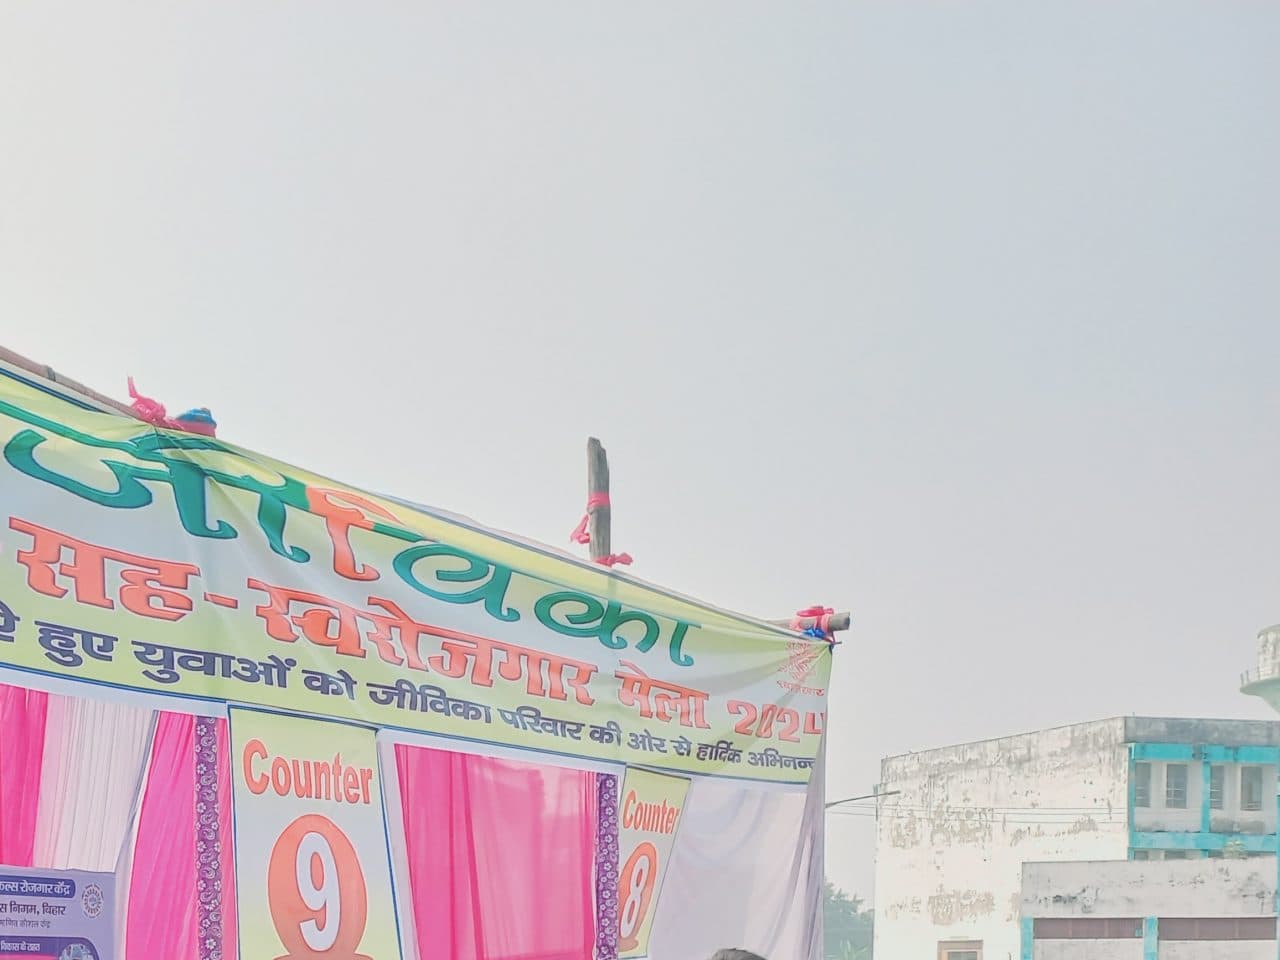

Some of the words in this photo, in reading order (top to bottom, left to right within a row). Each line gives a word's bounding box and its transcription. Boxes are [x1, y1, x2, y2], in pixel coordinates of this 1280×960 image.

[34, 619, 119, 668] हुए
[131, 639, 297, 690] युवाओं
[302, 667, 357, 701] को
[368, 678, 492, 724] जीविका
[498, 704, 585, 742] परिवार
[588, 719, 622, 746] की
[626, 728, 668, 754] ओर
[670, 736, 692, 757] से
[695, 740, 744, 764] हार्दिक
[614, 659, 711, 730] मेला
[241, 737, 374, 805] Counter
[622, 789, 681, 837] Counter
[10, 900, 40, 915] निगम,
[296, 831, 343, 953] 9
[622, 853, 648, 940] 8
